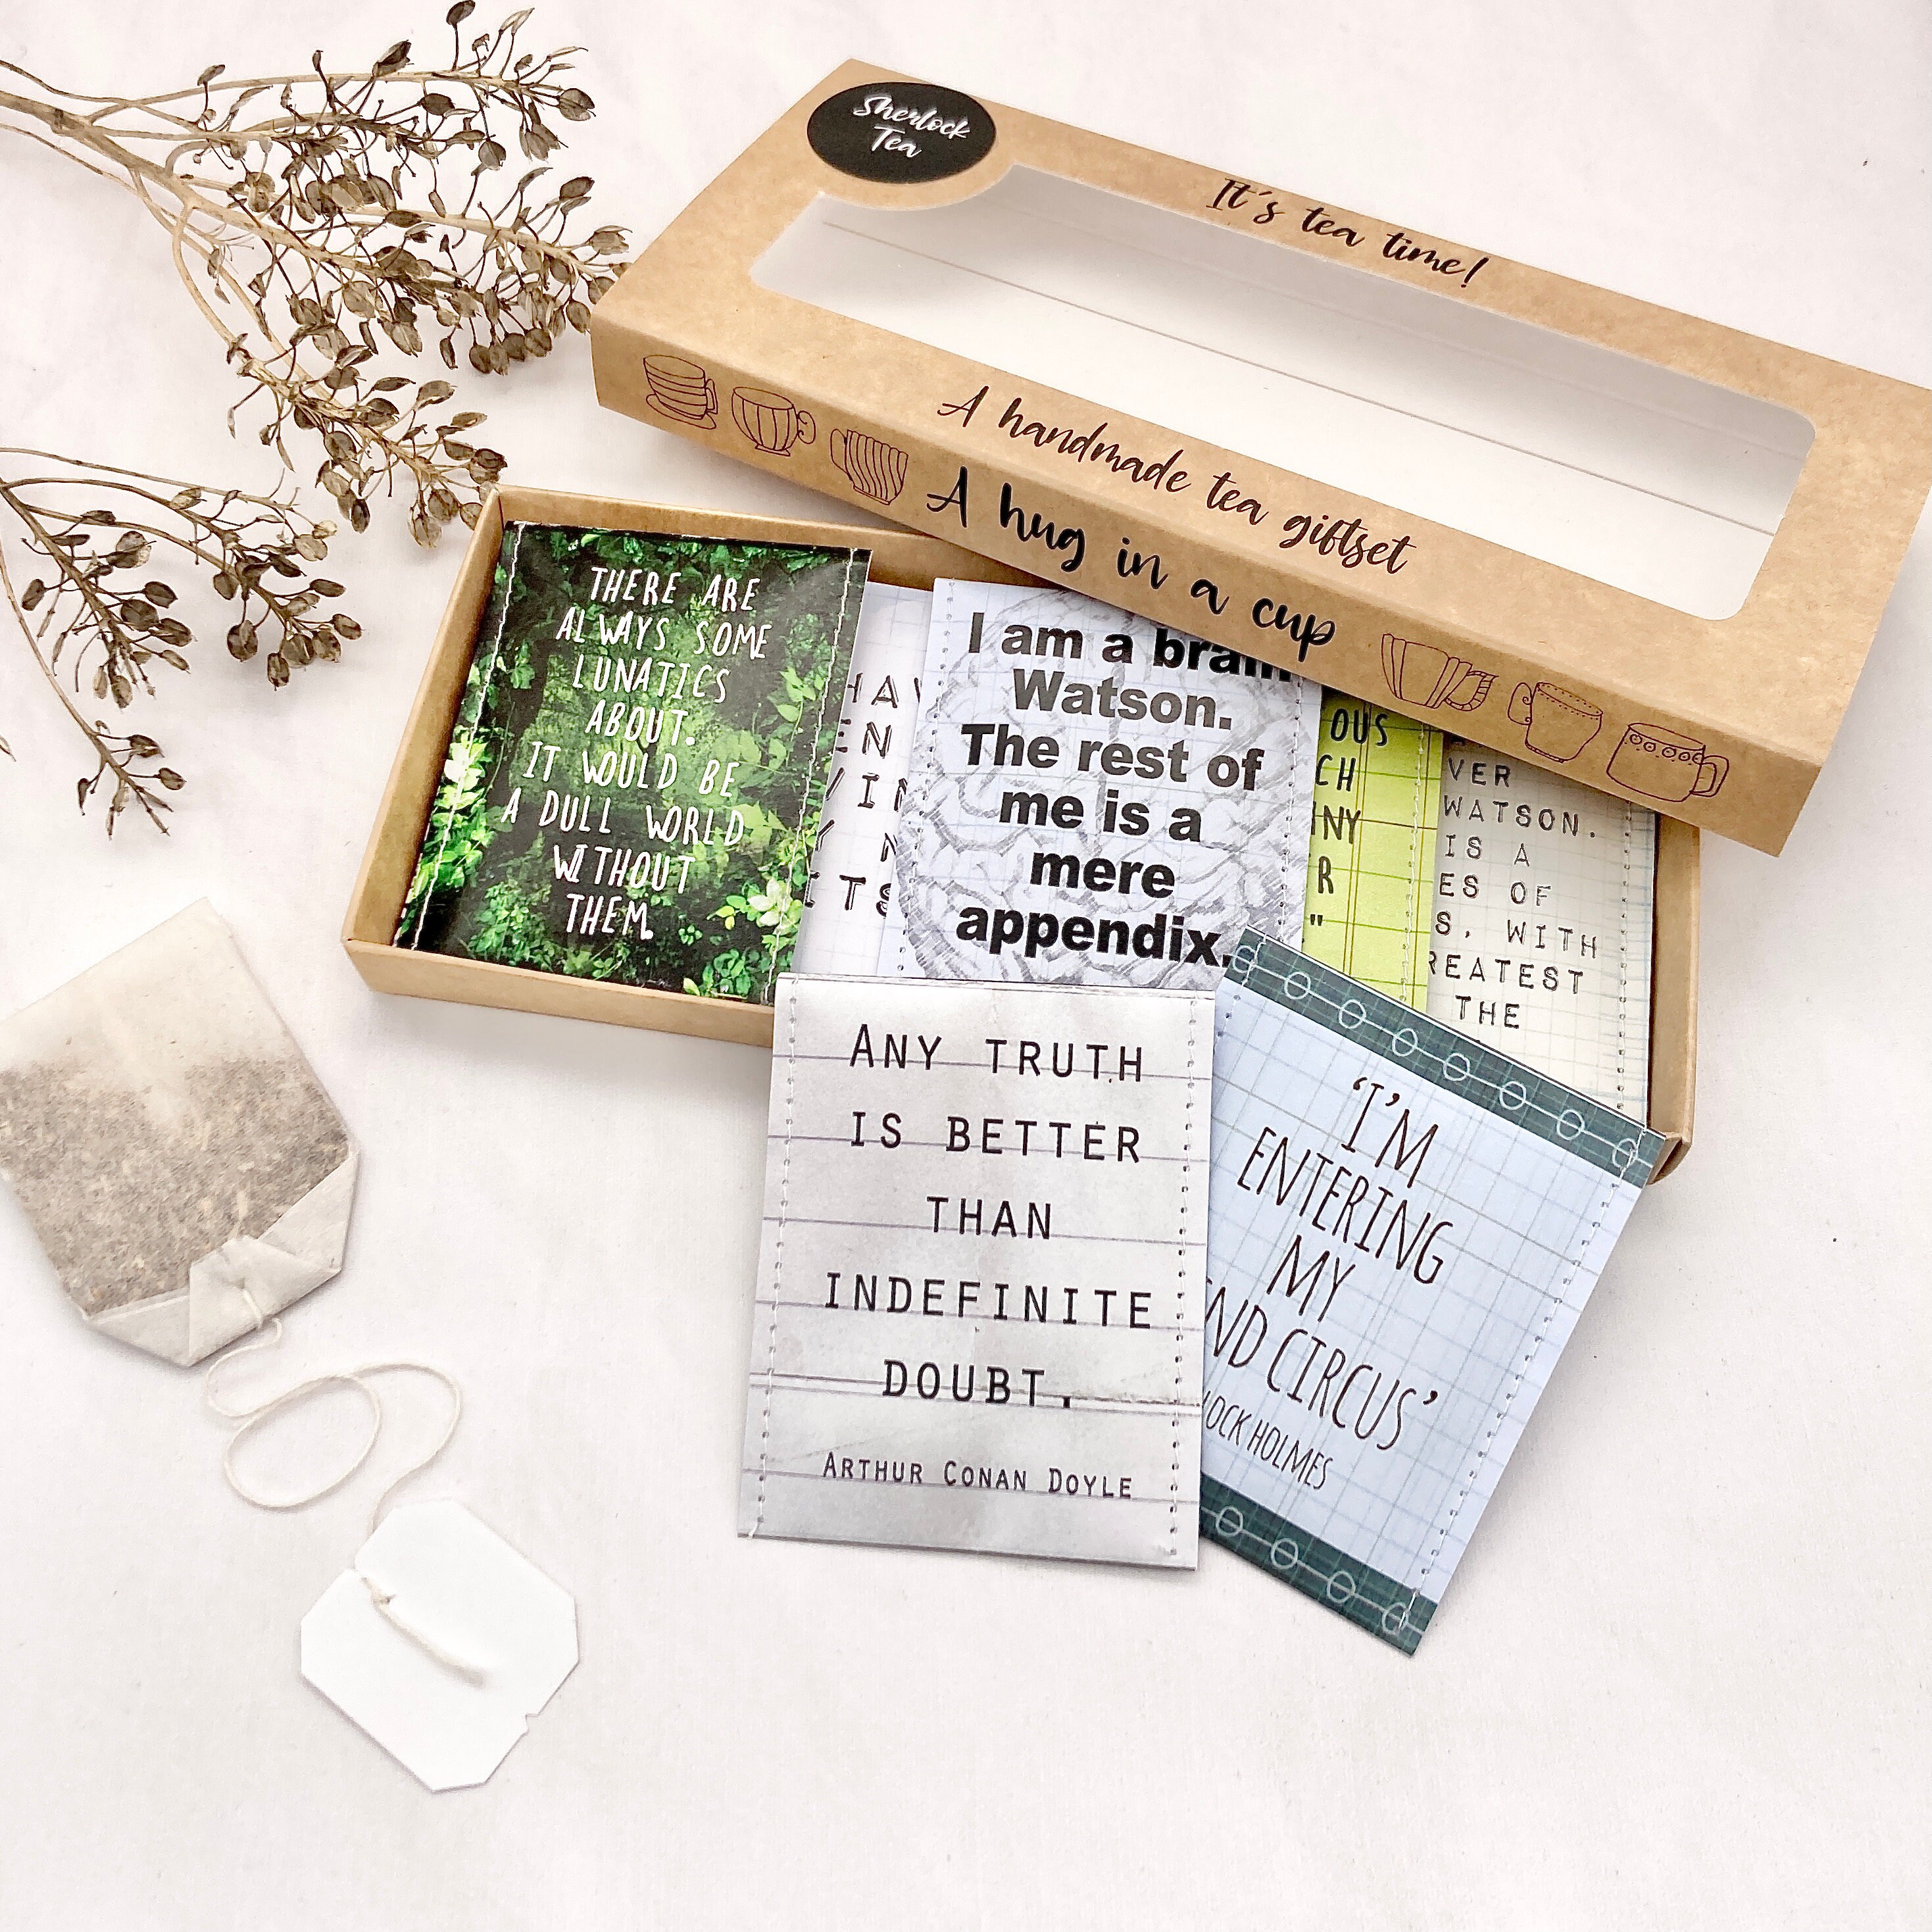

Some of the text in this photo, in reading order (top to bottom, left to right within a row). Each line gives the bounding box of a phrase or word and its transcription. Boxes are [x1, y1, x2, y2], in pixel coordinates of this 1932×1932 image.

[853, 96, 970, 139] Sherlock
[870, 126, 922, 158] Tea
[1206, 177, 1489, 289] It's tea time!
[937, 385, 1417, 574] A handmade tea giftset
[591, 566, 760, 612] THERE ARE
[926, 466, 1336, 662] A hug in a cup
[555, 607, 773, 660] ALWAYS SOME
[968, 612, 983, 653] I
[1001, 624, 1082, 658] am
[1102, 633, 1133, 664] a
[572, 653, 730, 704] LUNATICS
[1014, 668, 1232, 730] Watson.
[585, 701, 696, 747] ABOUT.
[522, 741, 740, 798] IT WOULD BE
[960, 724, 1264, 791] The rest of
[1448, 757, 1512, 787] VER
[501, 788, 745, 846] A DULL WORLD
[999, 789, 1201, 843] me is a
[1443, 795, 1597, 837] WATSON.
[553, 844, 695, 894] WITHOUT
[1029, 851, 1175, 899] mere
[1445, 834, 1530, 868] IS A
[1439, 872, 1551, 906] ES OF
[566, 894, 654, 941] THEM.
[956, 903, 1232, 968] appendix.
[1507, 919, 1597, 959] WITH
[1455, 994, 1520, 1029] THE
[851, 1024, 1143, 1082] ANY TRUTH
[851, 1111, 1140, 1164] IS BETTER
[927, 1196, 1051, 1239] THAN
[1237, 1126, 1453, 1284] ENTERING
[826, 1272, 1152, 1329] INDEFINITE
[1266, 1234, 1355, 1322] MY
[1205, 1276, 1267, 1368] ND
[883, 1359, 1072, 1408] DOUBT.
[823, 1452, 1132, 1499] ARTHUR CONAN DOYLE
[1247, 1419, 1333, 1489] HOLMES
